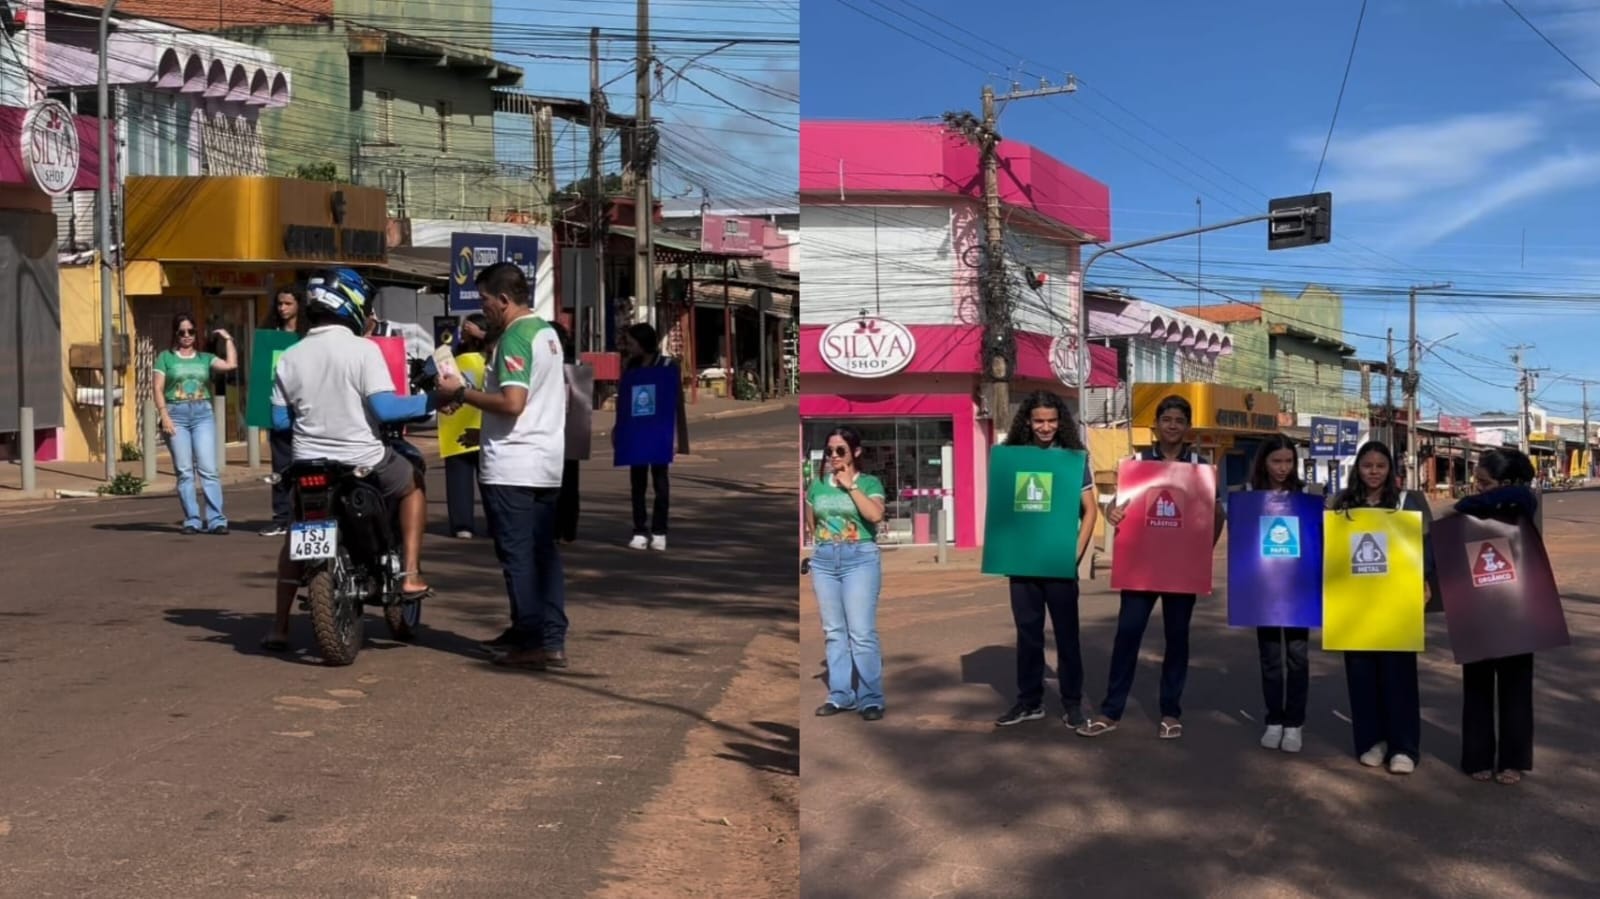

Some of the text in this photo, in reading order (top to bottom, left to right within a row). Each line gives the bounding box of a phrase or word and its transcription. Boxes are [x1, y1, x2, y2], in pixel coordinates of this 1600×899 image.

[33, 129, 76, 168] SILVA
[44, 169, 64, 183] SHOP
[827, 334, 907, 359] SILVA
[851, 359, 888, 369] SHOP
[301, 528, 326, 542] TSJ
[295, 541, 330, 556] 4B36
